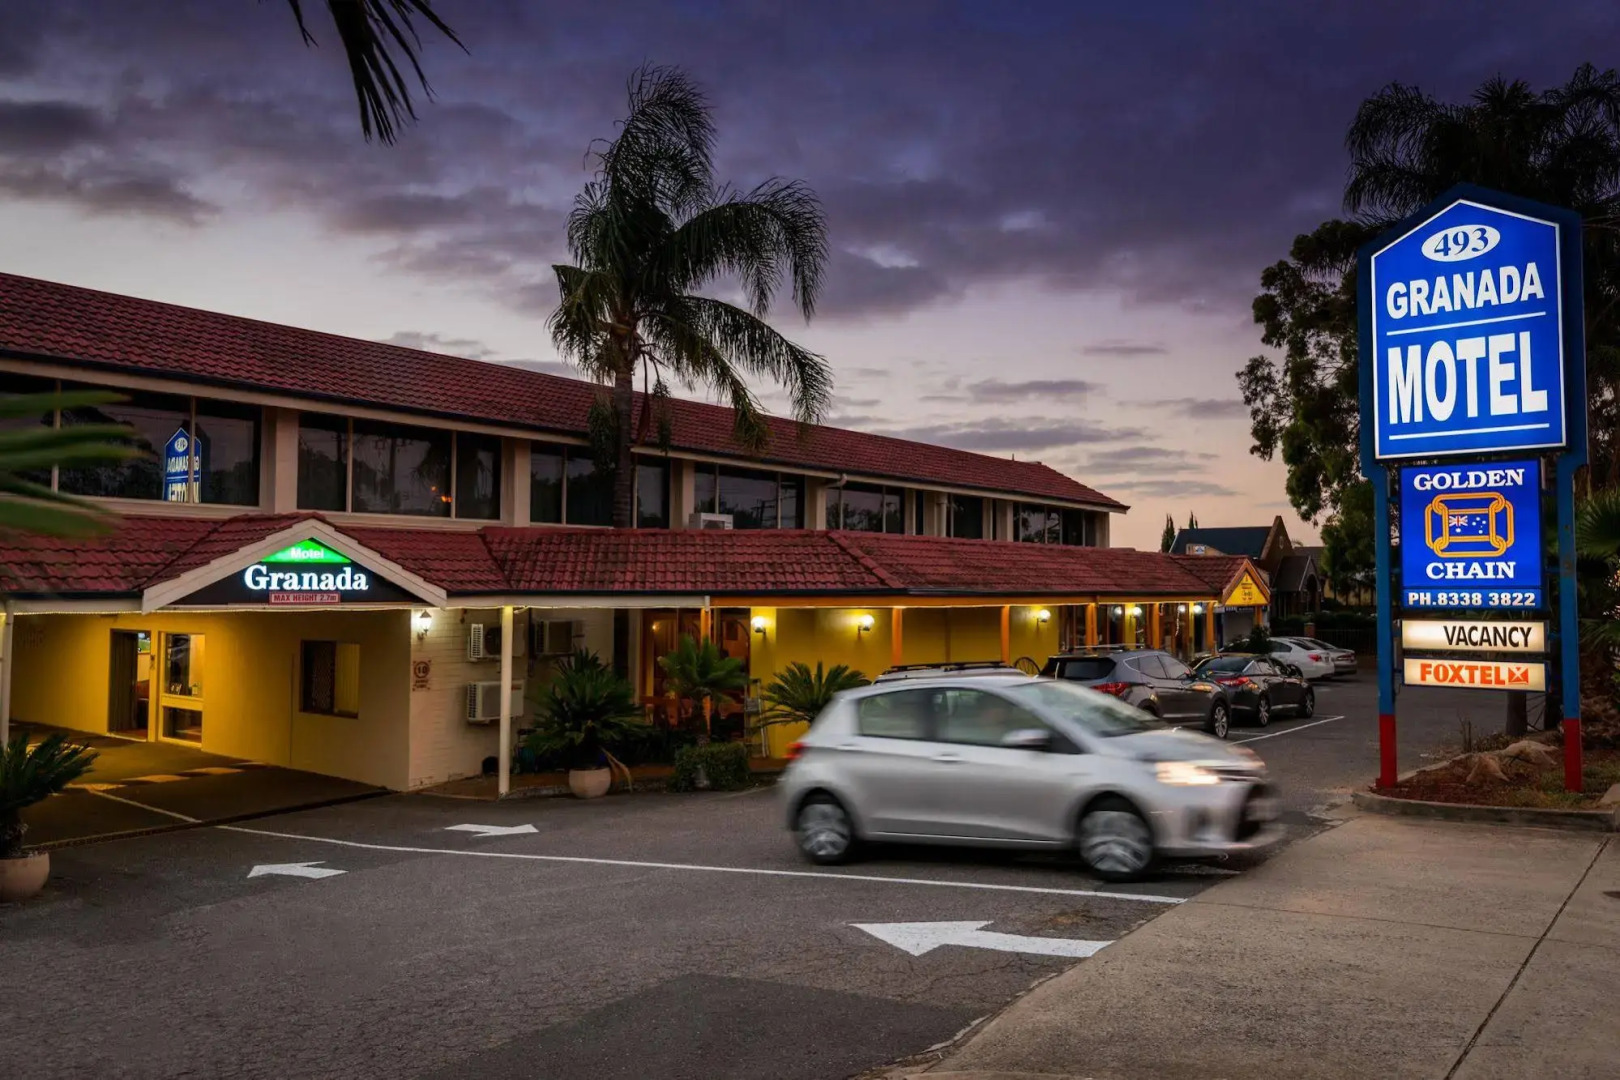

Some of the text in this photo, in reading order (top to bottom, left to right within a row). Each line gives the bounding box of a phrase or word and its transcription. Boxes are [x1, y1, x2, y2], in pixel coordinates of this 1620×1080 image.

[1433, 227, 1489, 257] 493
[1386, 261, 1545, 320] GRANADA
[1387, 330, 1548, 425] MOTEL
[1413, 468, 1525, 491] GOLDEN
[290, 547, 324, 560] Motel
[244, 564, 368, 590] Granada
[1425, 560, 1516, 580] CHAIN
[273, 594, 337, 602] MAX HEIGHT 2.7m
[1408, 591, 1536, 606] PH.8338 3822
[1443, 625, 1533, 648] VACANCY
[1420, 662, 1506, 685] FOXTEL
